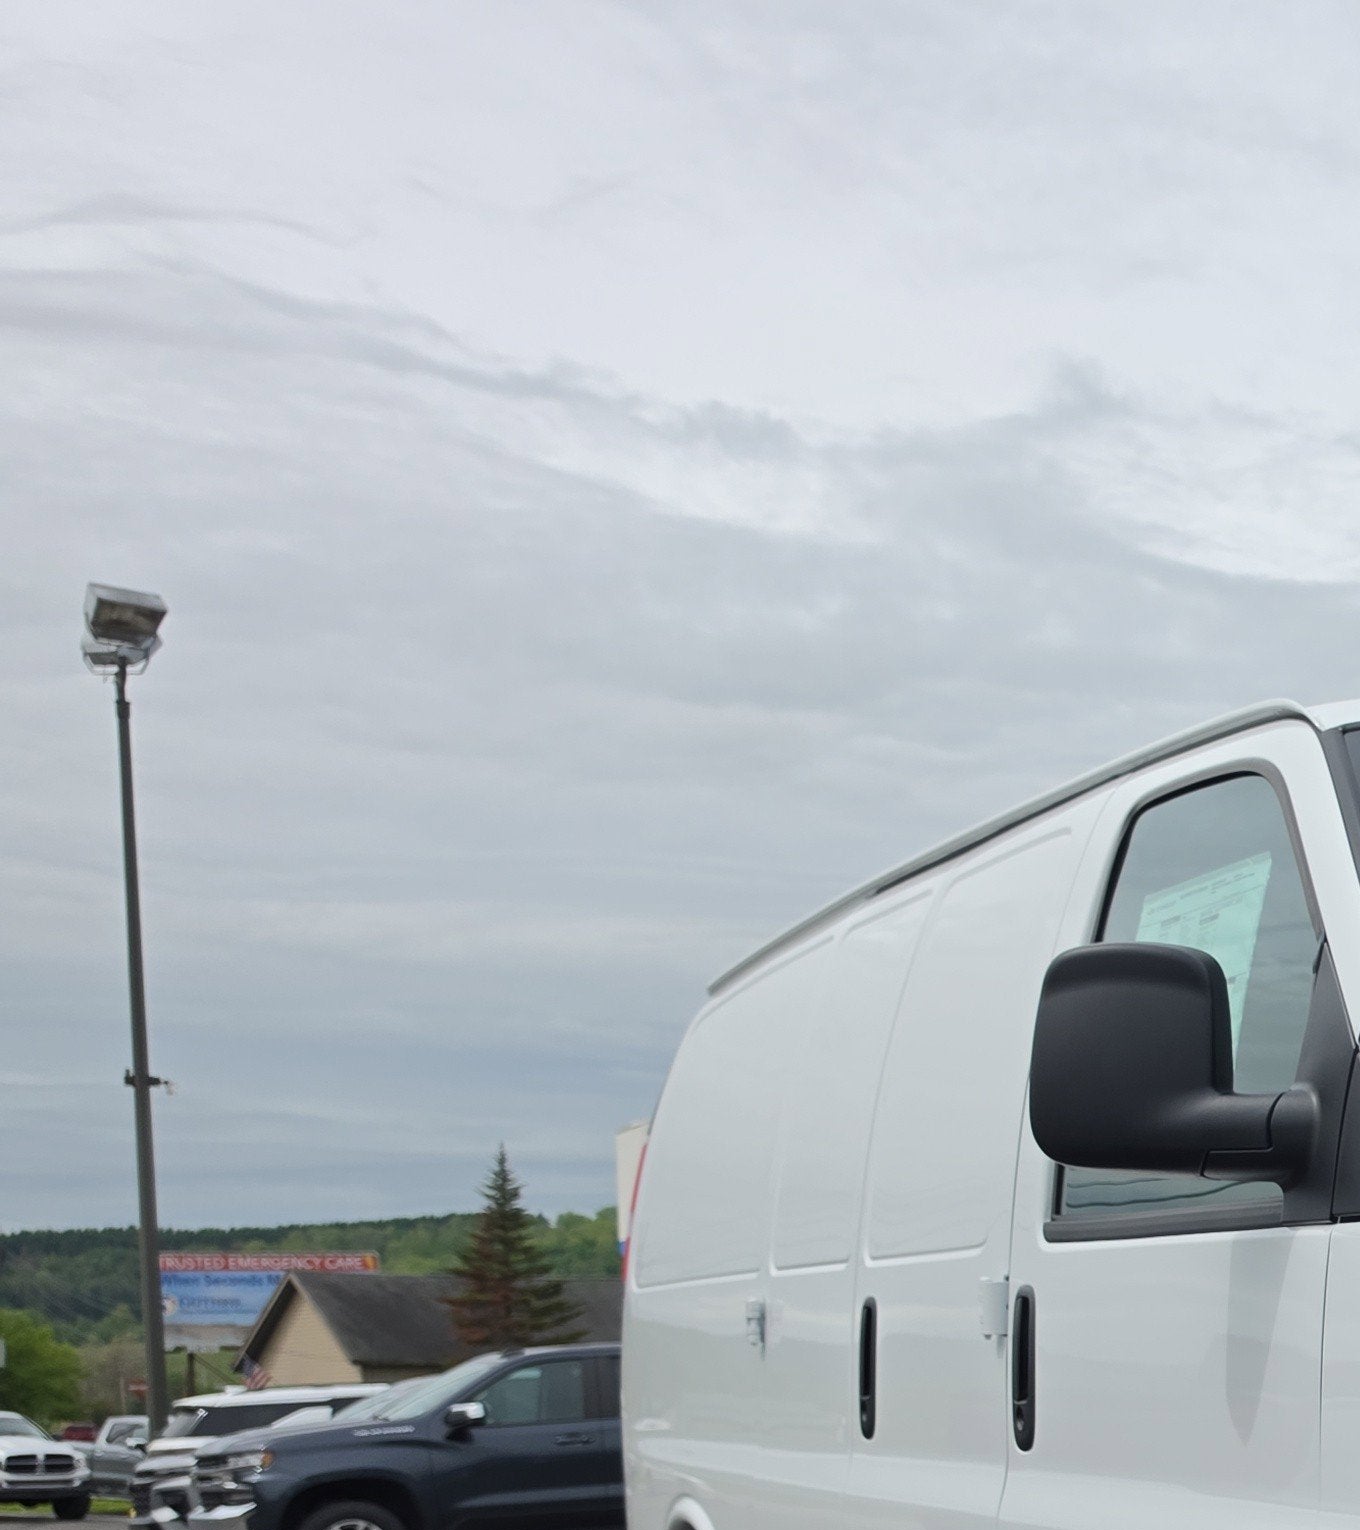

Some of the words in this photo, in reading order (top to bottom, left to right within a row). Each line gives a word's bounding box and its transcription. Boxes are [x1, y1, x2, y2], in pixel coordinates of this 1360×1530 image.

[159, 1255, 226, 1270] TRUSTED
[228, 1255, 321, 1270] EMERGENCY
[324, 1255, 362, 1270] CARE
